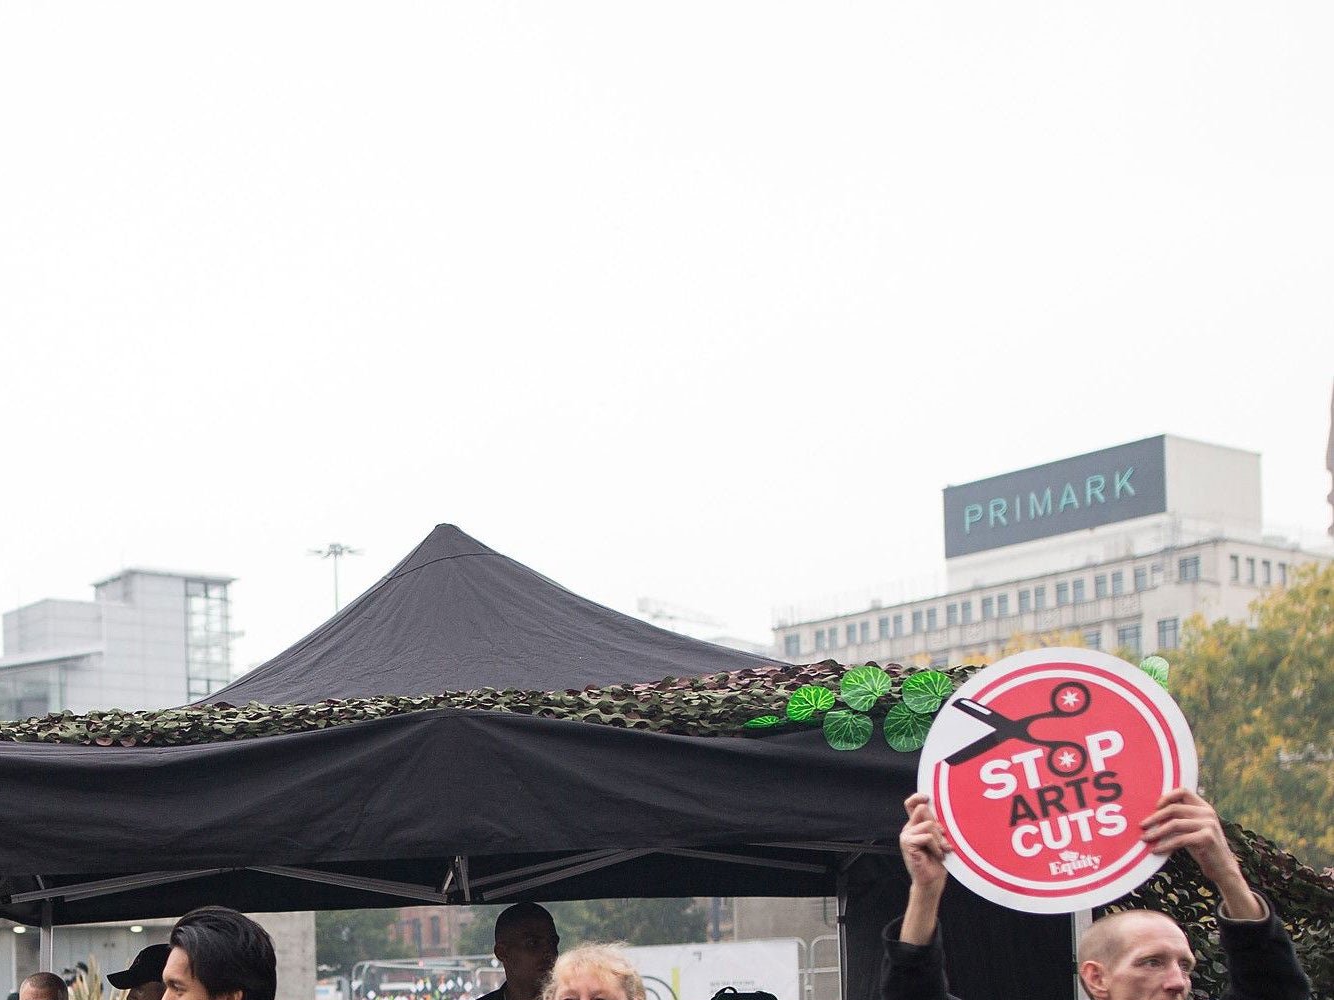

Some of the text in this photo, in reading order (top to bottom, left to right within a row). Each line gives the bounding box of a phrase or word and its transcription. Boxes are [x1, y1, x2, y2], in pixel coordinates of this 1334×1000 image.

[964, 467, 1135, 534] PRIMARK
[980, 731, 1124, 799] STOP
[1012, 771, 1123, 825] ARTS
[1012, 805, 1127, 856] CUTS
[1048, 852, 1102, 876] Equity
